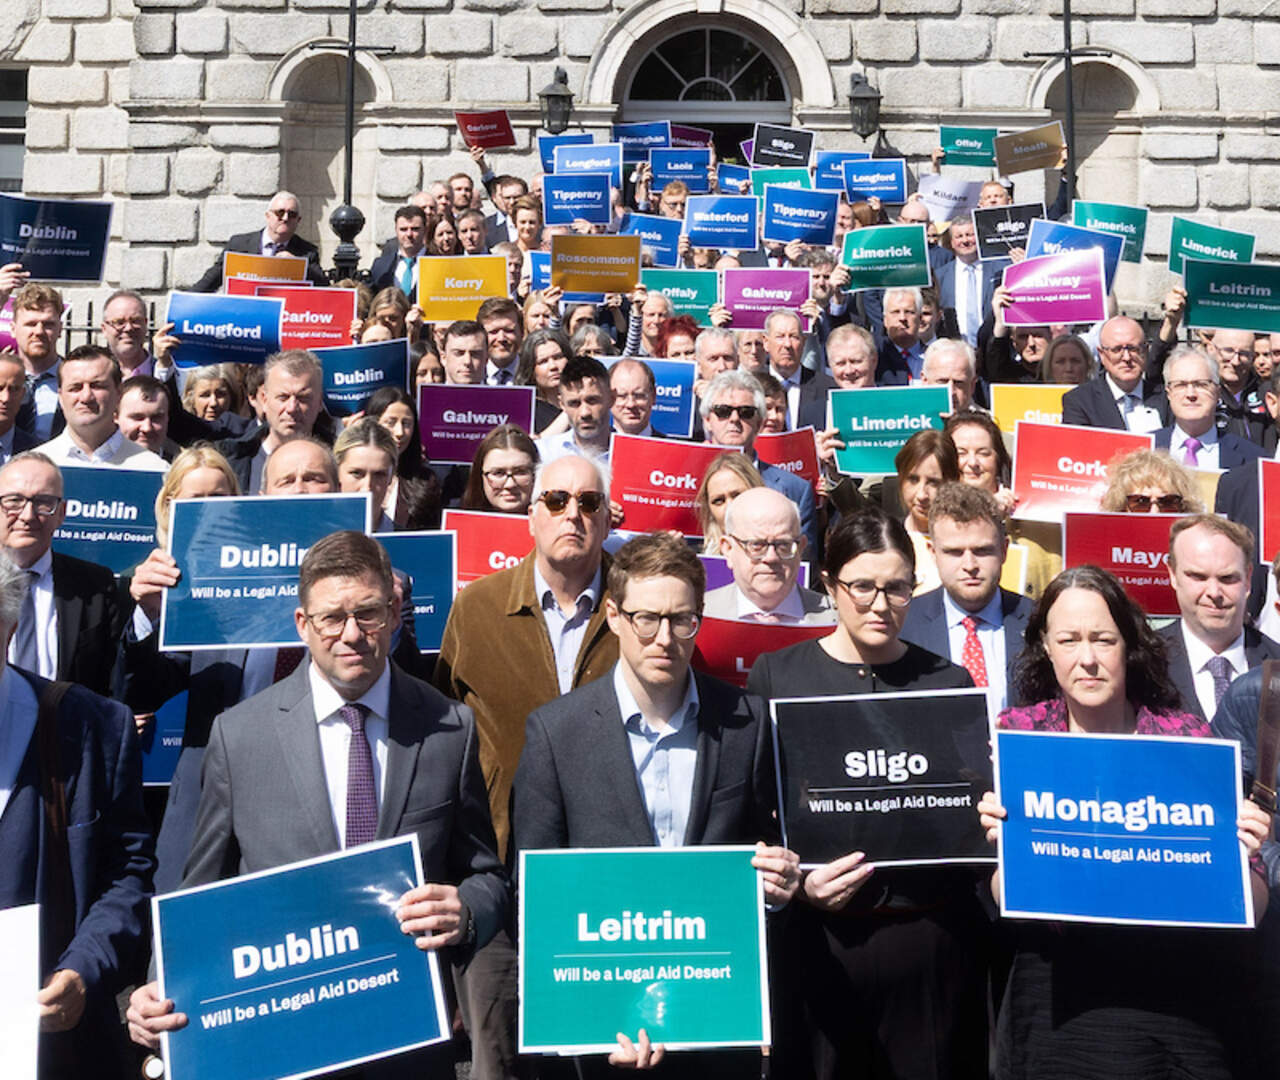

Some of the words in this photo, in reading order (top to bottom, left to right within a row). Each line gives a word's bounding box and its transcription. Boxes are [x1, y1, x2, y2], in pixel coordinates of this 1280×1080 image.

[955, 139, 982, 149] Offaly
[853, 173, 896, 183] Longford
[552, 190, 602, 200] Tipperary
[693, 212, 749, 223] Waterford
[773, 203, 827, 220] Tipperary
[19, 223, 78, 240] Dublin
[852, 246, 912, 260] Limerick
[1182, 237, 1237, 260] Limerick
[557, 253, 635, 265] Roscommon
[445, 277, 483, 290] Kerry
[1210, 282, 1271, 296] Leitrim
[742, 287, 792, 301] Galway
[183, 320, 261, 339] Longford
[334, 369, 384, 385] Dublin
[443, 410, 508, 425] Galway
[852, 415, 932, 431] Limerick
[1024, 410, 1063, 424] Clar
[1058, 456, 1108, 477] Cork
[650, 470, 697, 489] Cork
[623, 494, 637, 502] Will
[656, 497, 678, 507] Legal
[679, 499, 692, 507] Aid
[65, 500, 138, 520] Dublin
[61, 530, 71, 539] be
[81, 531, 106, 541] Legal
[107, 532, 123, 541] Aid
[124, 533, 154, 543] Desert
[192, 588, 214, 599] Will
[216, 587, 231, 598] be
[233, 588, 241, 598] a
[244, 585, 276, 599] Legal
[278, 585, 298, 596] Aid
[163, 737, 182, 746] Will
[844, 749, 929, 782] Sligo
[809, 799, 833, 812] Will
[835, 799, 852, 812] be
[854, 801, 864, 811] a
[866, 797, 901, 813] Legal
[903, 796, 924, 808] Aid
[927, 794, 971, 807] Desert
[1023, 790, 1215, 832] Monaghan
[1032, 841, 1059, 856] Will
[1061, 843, 1080, 858] be
[1082, 846, 1092, 859] a
[1094, 846, 1133, 863] Legal
[1136, 847, 1160, 862] Aid
[1163, 850, 1211, 864] Desert
[578, 910, 706, 941] Leitrim
[232, 924, 360, 980] Dublin
[553, 967, 580, 982] Will
[583, 967, 601, 981] be
[603, 970, 613, 980] a
[615, 966, 654, 983] Legal
[657, 966, 680, 980] Aid
[683, 965, 731, 978] Desert
[201, 1008, 233, 1029] Will
[235, 1005, 256, 1022] be
[258, 1003, 269, 1016] a
[271, 988, 316, 1012] Legal
[318, 981, 345, 1002] Aid
[347, 968, 400, 995] Desert
